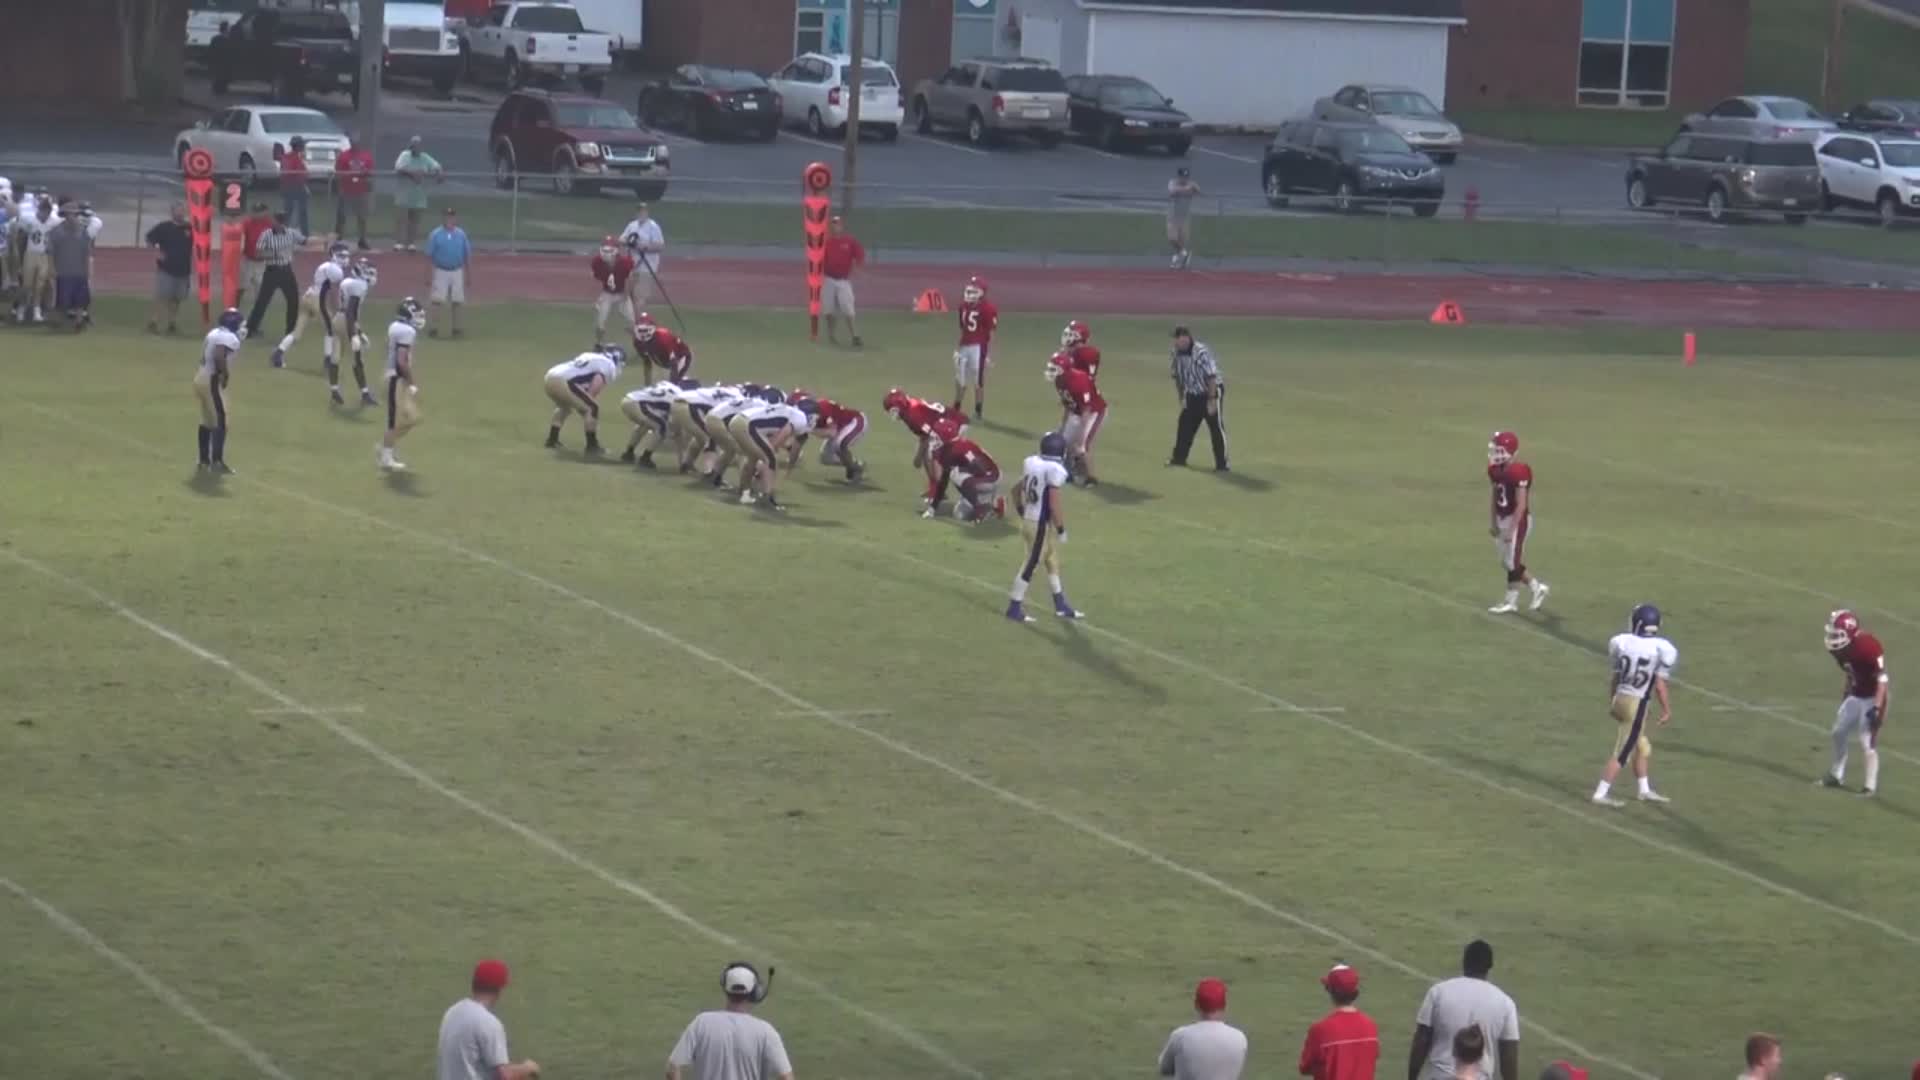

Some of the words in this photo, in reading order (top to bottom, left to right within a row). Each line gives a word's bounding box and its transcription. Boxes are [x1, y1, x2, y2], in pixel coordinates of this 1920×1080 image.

[226, 183, 241, 208] 2
[607, 273, 617, 291] 4
[927, 292, 942, 311] 10
[962, 311, 979, 332] 15
[1445, 304, 1457, 320] G
